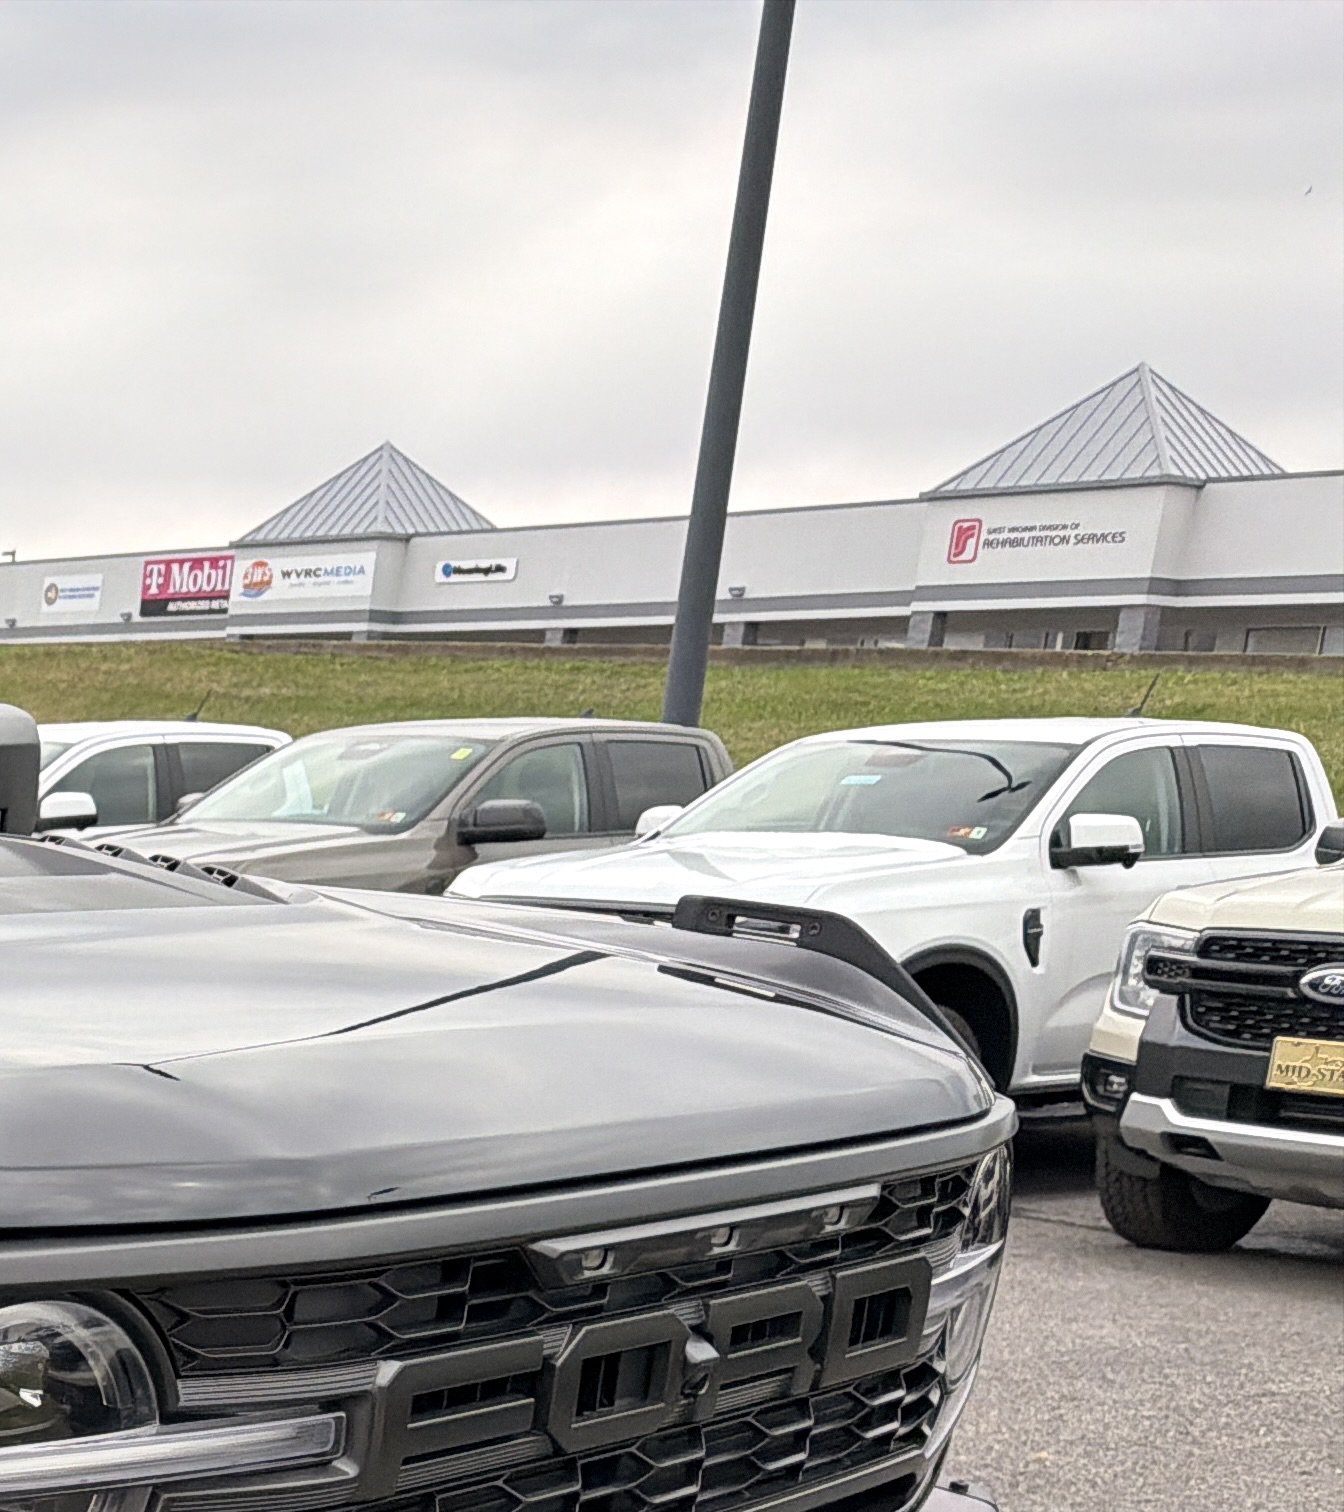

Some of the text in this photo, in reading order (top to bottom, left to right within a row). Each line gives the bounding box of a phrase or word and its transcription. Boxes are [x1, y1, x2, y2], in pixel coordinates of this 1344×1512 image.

[982, 531, 1126, 549] REHABILITATION SERVICES
[354, 1254, 933, 1499] FORD
